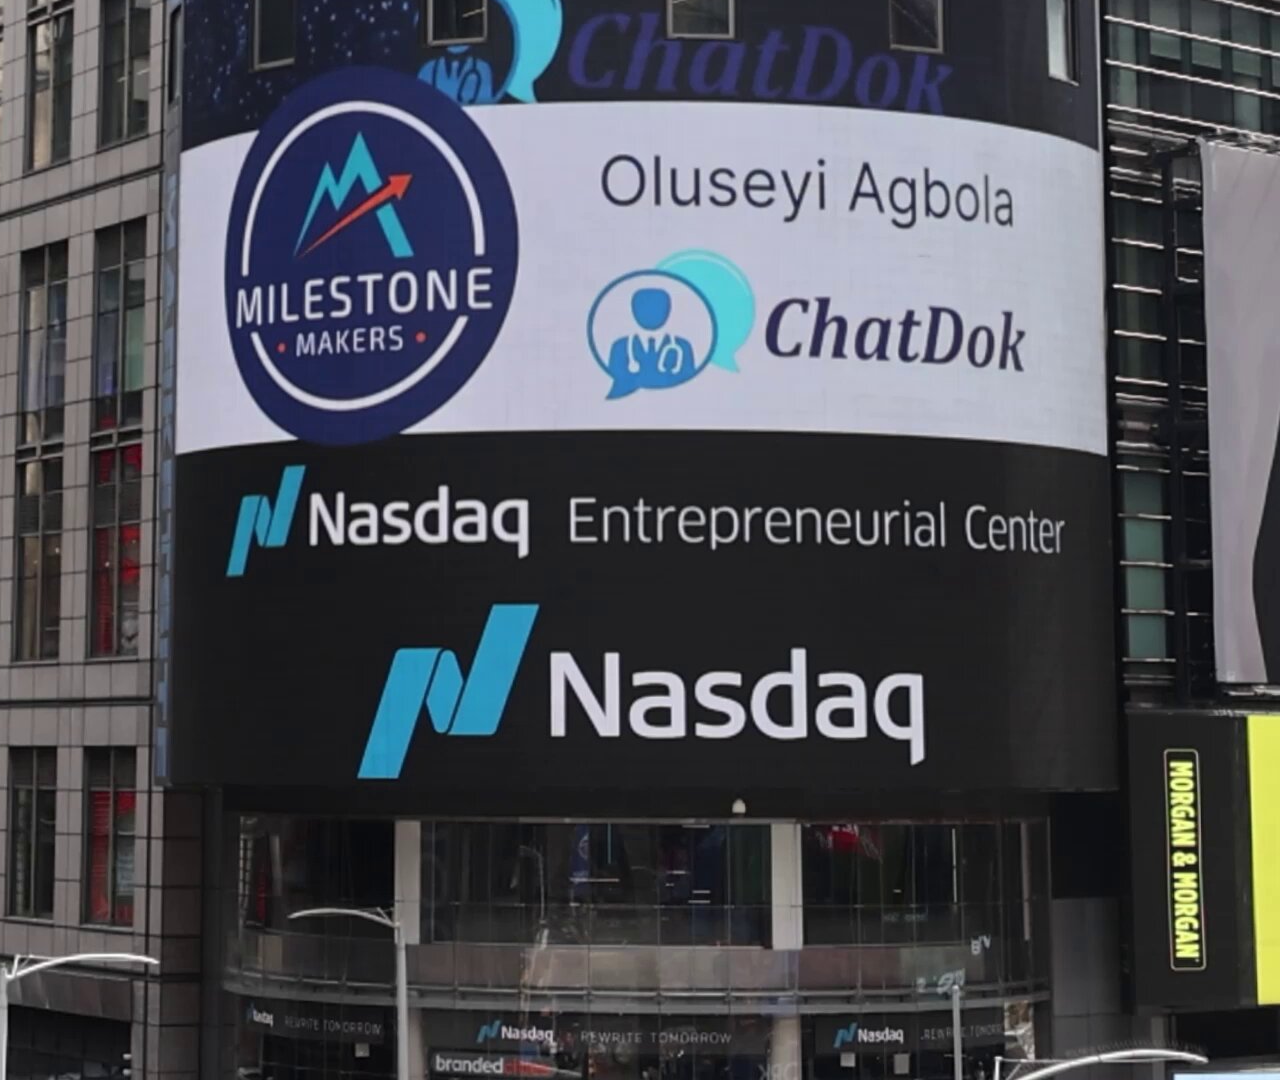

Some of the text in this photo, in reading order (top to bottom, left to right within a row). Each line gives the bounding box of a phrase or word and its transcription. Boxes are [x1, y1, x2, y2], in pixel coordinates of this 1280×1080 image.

[569, 12, 954, 115] ChatDok
[600, 153, 1015, 230] Oluseyi Agbola
[235, 266, 494, 329] MILESTONE
[295, 324, 405, 358] MAKERS
[764, 296, 1026, 373] ChatDok
[309, 485, 1065, 558] Nasdaq Entrepreneurial Center
[549, 647, 926, 765] Nasdaq
[1170, 761, 1200, 959] MORGAN & MORGAN
[501, 1021, 553, 1042] Nasdaq
[580, 1032, 732, 1044] REWRITE TOMORROW
[857, 1027, 904, 1043] Nasdaq
